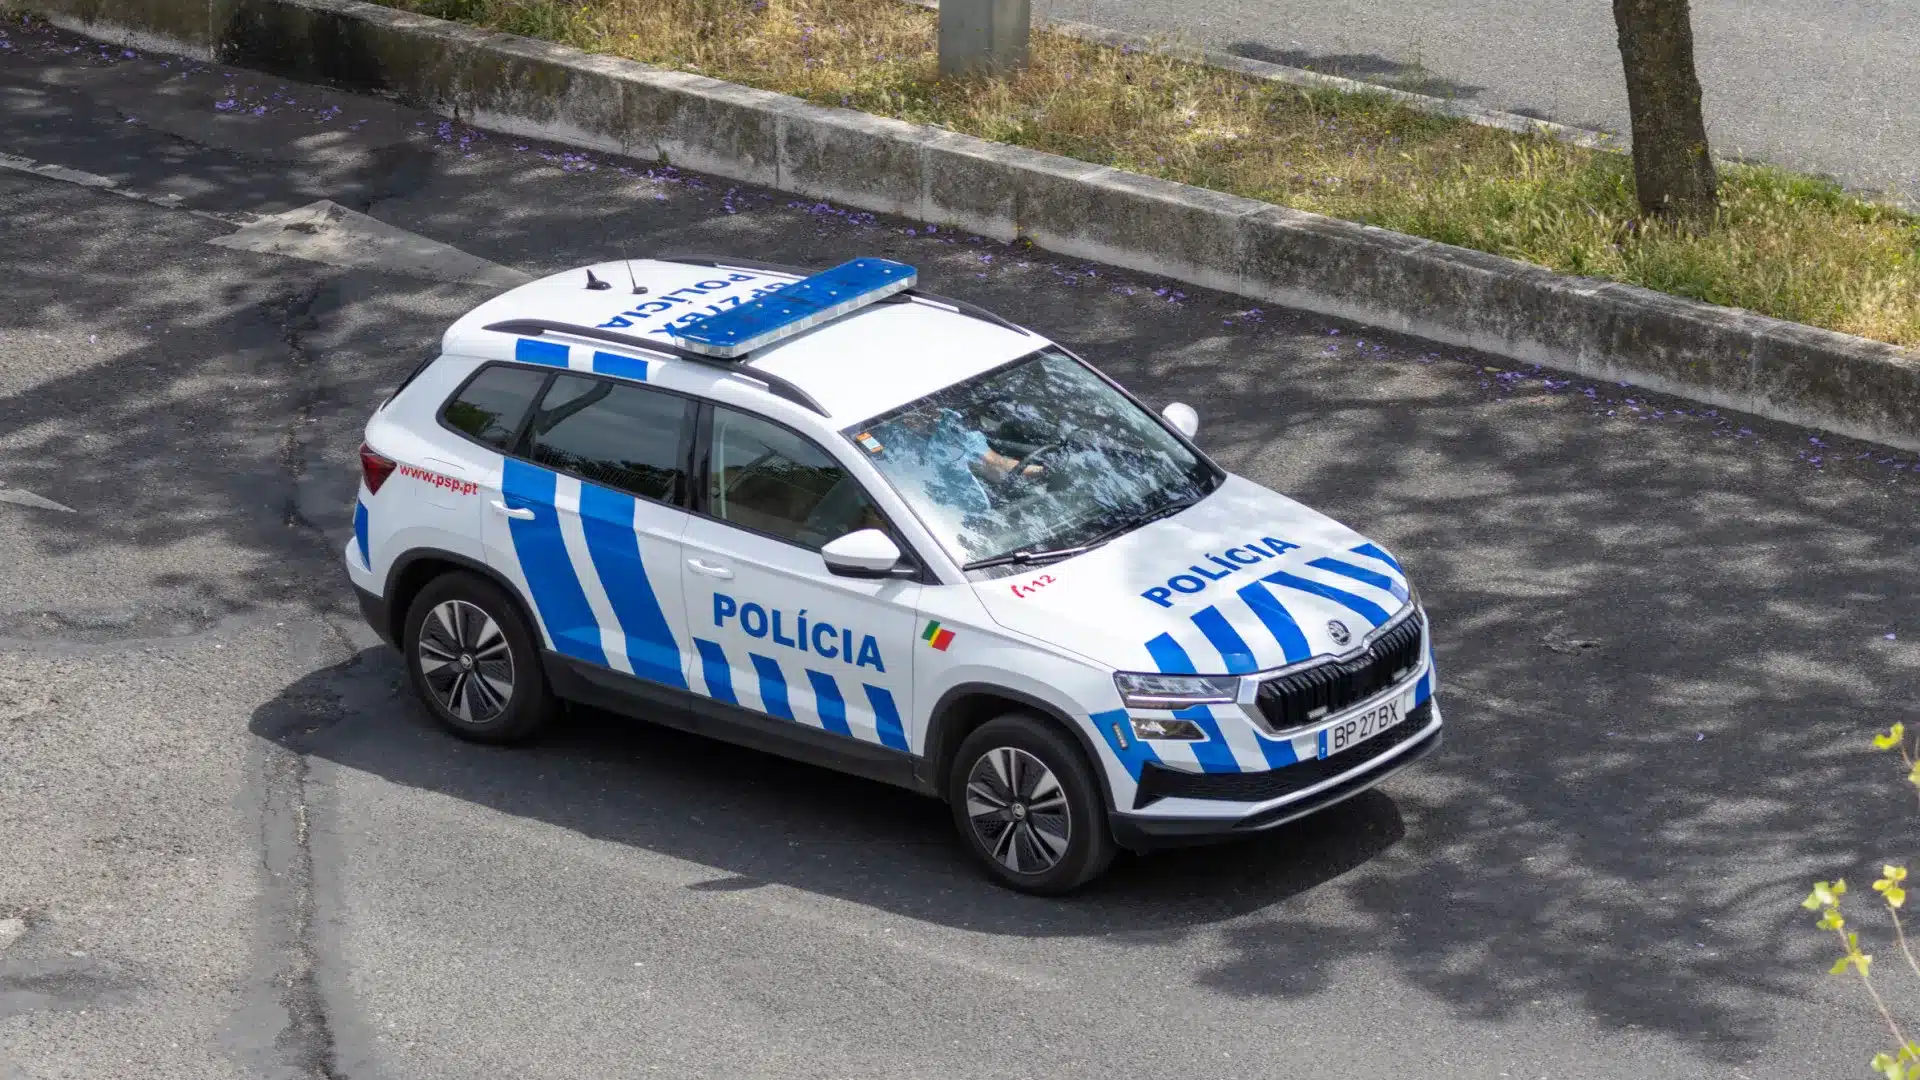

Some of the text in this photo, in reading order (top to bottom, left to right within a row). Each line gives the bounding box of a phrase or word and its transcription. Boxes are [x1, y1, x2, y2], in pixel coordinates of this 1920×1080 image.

[595, 273, 757, 329] POLÍCIA
[399, 464, 478, 495] www.psp.pt
[1022, 575, 1057, 592] 112
[1140, 536, 1301, 608] POLÍCIA
[713, 591, 886, 674] POLÍCIA
[1334, 700, 1398, 749] BP 27 BX
